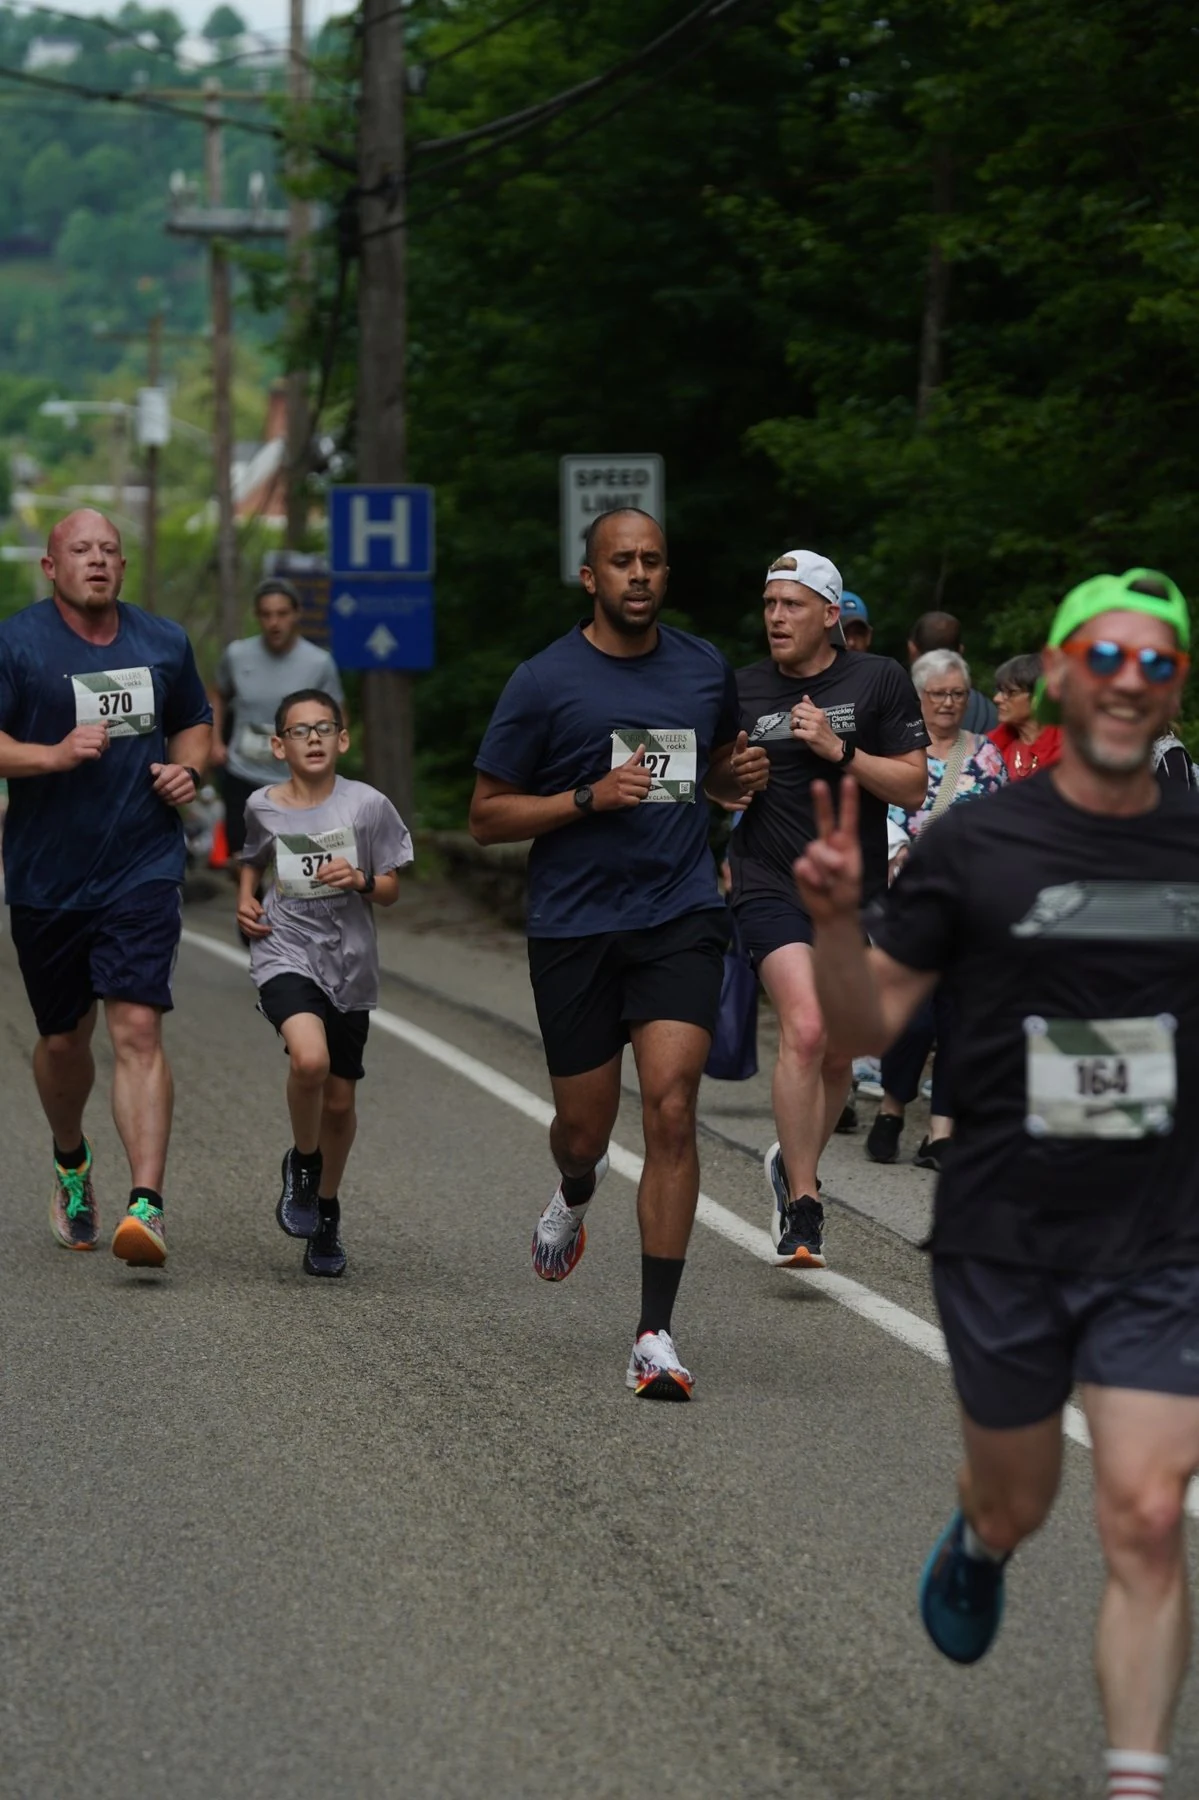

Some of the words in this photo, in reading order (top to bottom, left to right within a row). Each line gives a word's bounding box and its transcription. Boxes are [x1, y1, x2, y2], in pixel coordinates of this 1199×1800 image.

[575, 468, 650, 488] SPEED
[350, 494, 410, 568] H
[99, 692, 133, 716] 370
[649, 734, 687, 746] JEWELERS
[1075, 1058, 1128, 1095] 164
